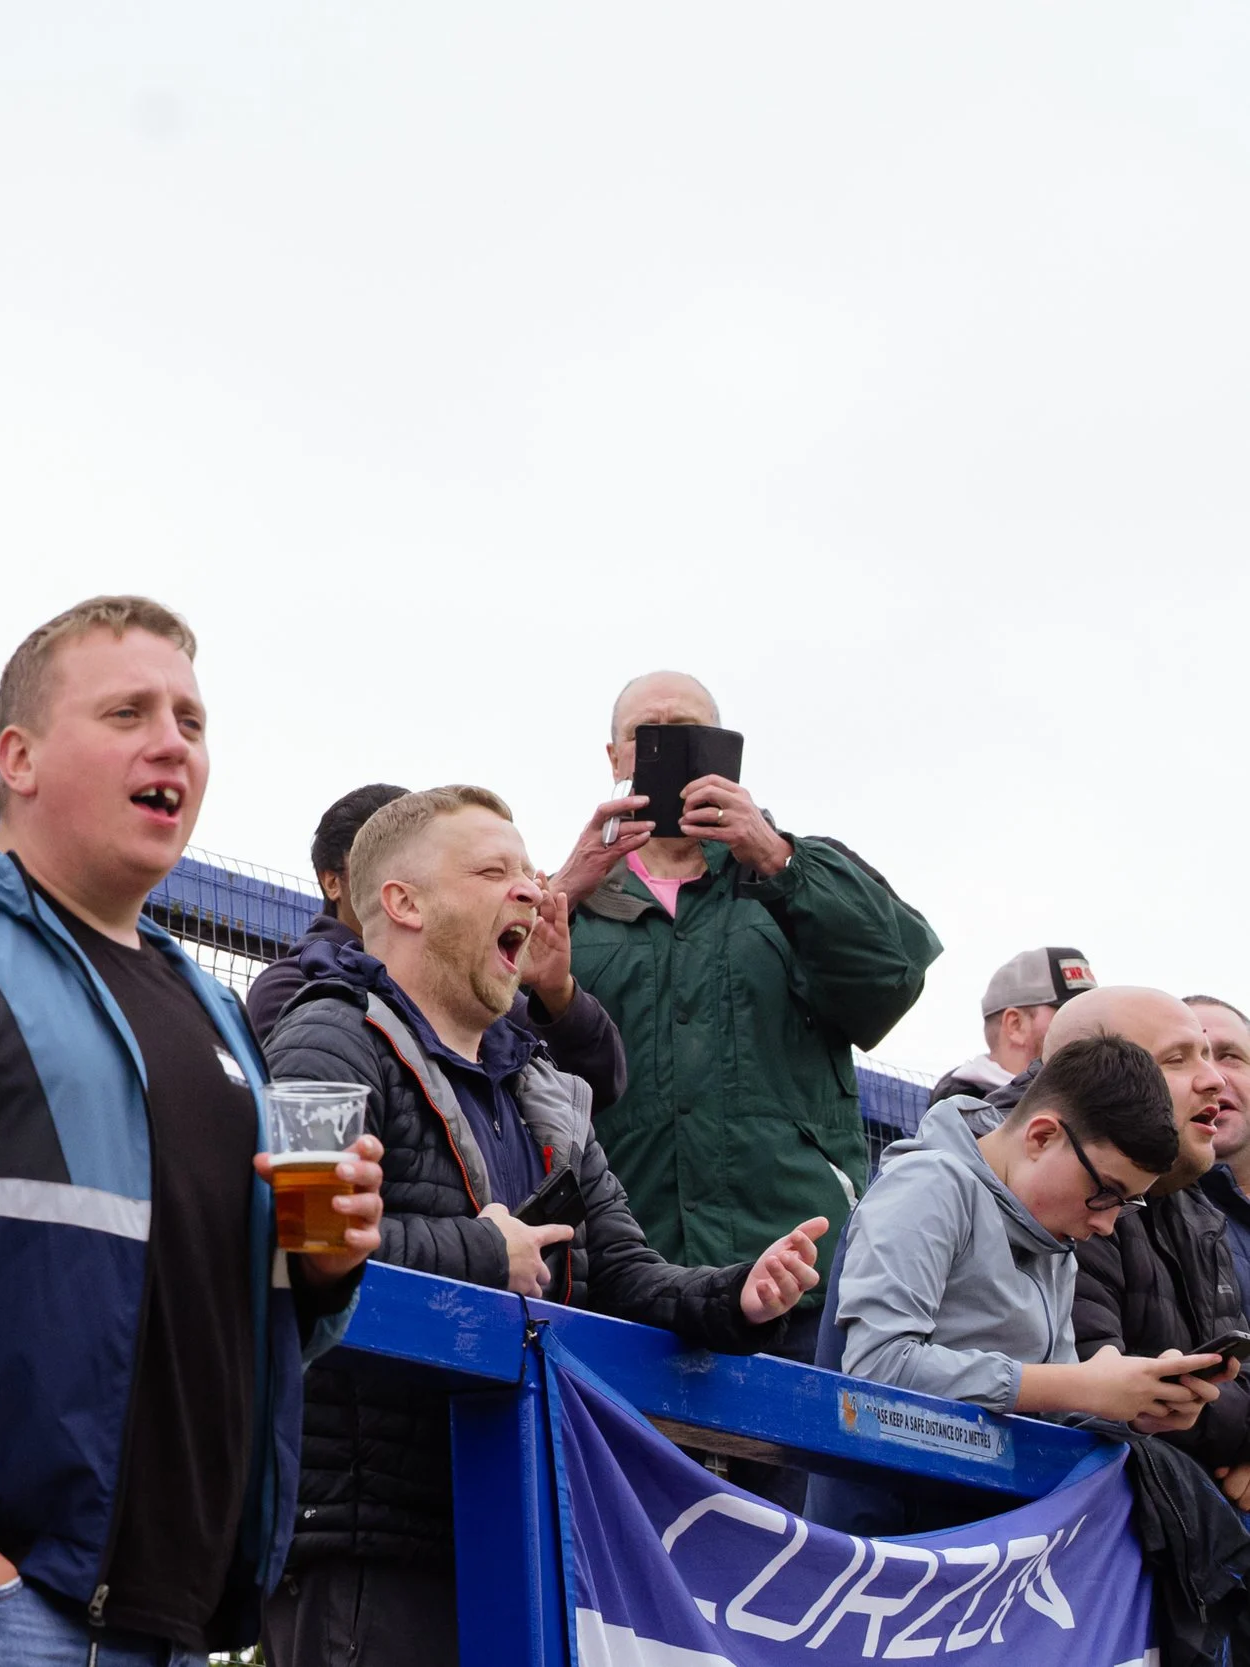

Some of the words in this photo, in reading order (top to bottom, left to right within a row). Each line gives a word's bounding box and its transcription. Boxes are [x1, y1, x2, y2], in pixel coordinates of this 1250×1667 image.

[889, 1411, 903, 1428] KEEP
[910, 1416, 925, 1434] SAFE
[925, 1420, 954, 1441] DISTANCE
[955, 1428, 963, 1443] OF
[968, 1430, 992, 1449] METRES
